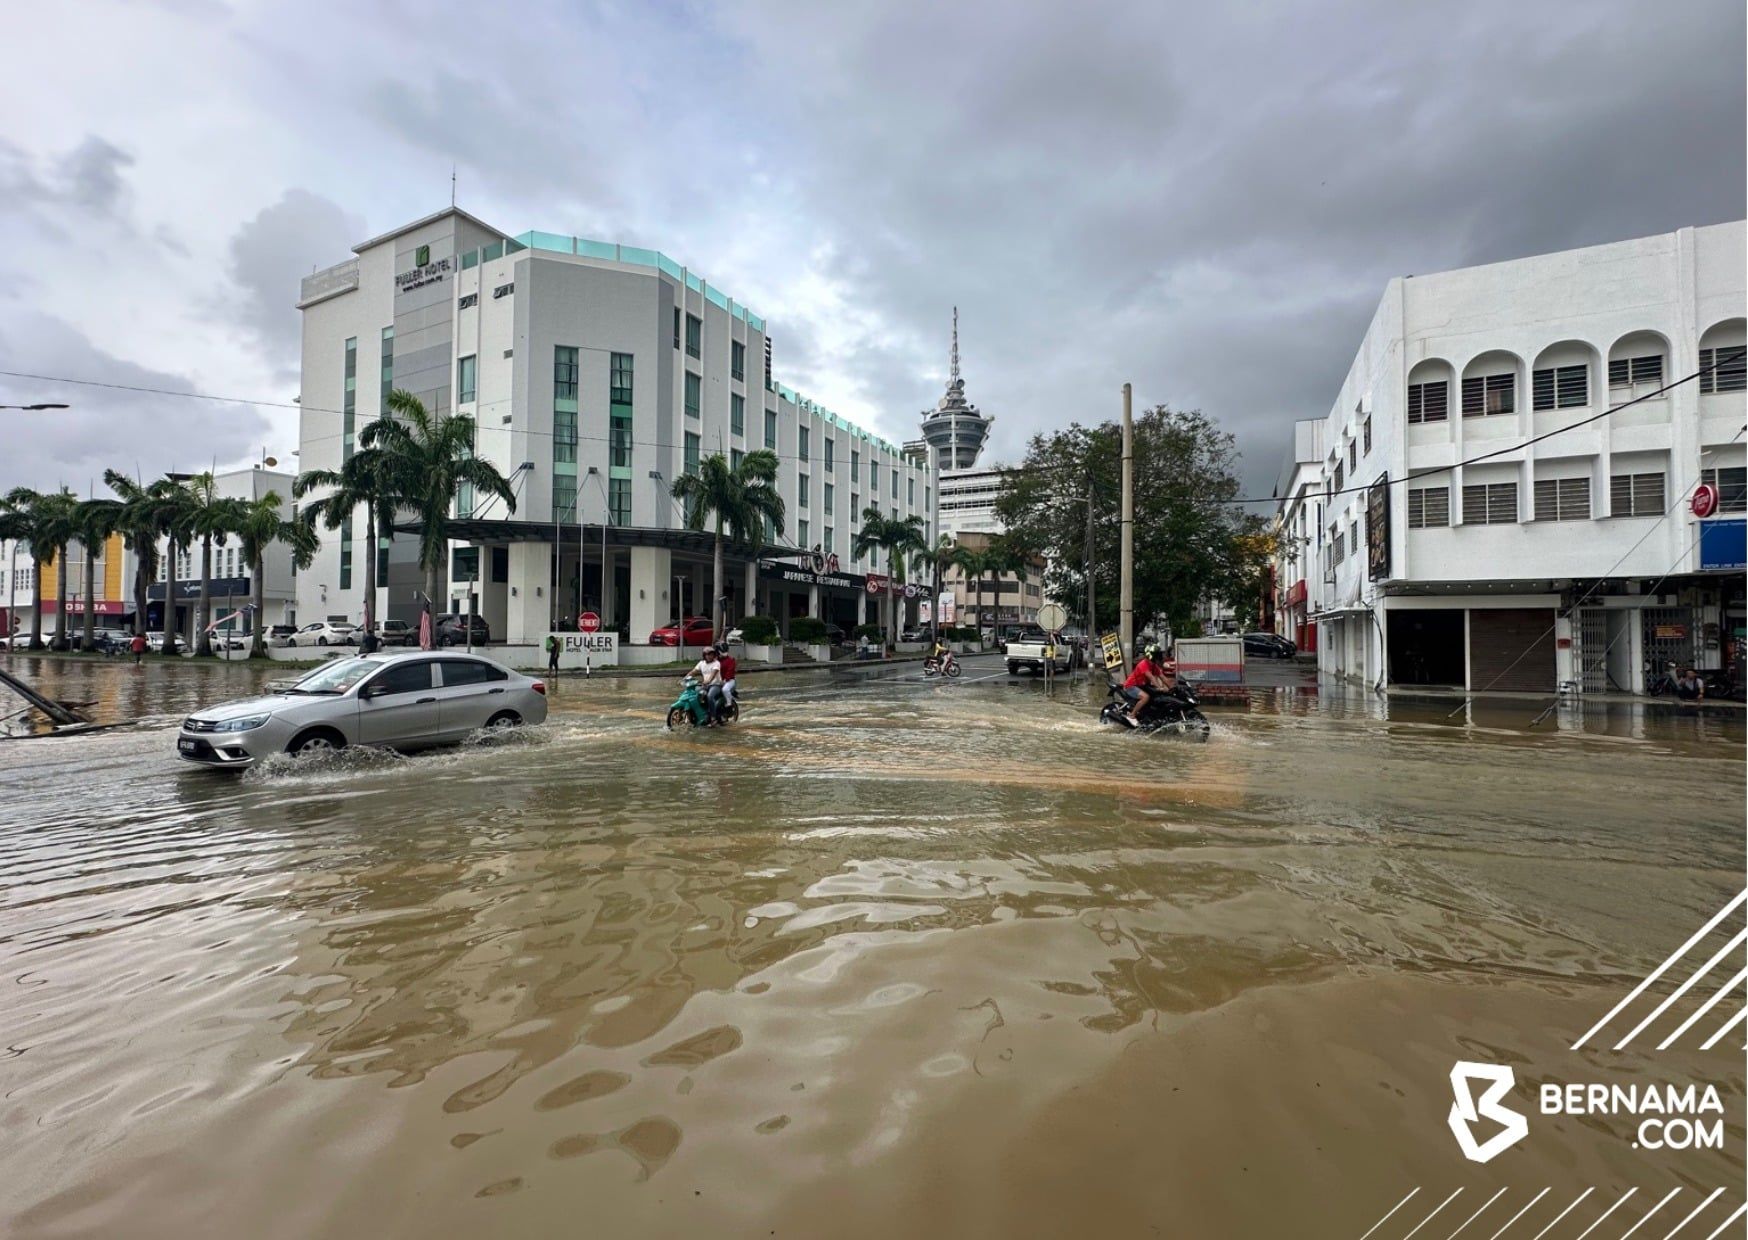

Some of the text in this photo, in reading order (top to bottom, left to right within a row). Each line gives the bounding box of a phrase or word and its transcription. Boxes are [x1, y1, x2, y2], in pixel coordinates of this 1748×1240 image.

[395, 259, 451, 287] FULLER HOTEL
[566, 636, 612, 647] FULLER
